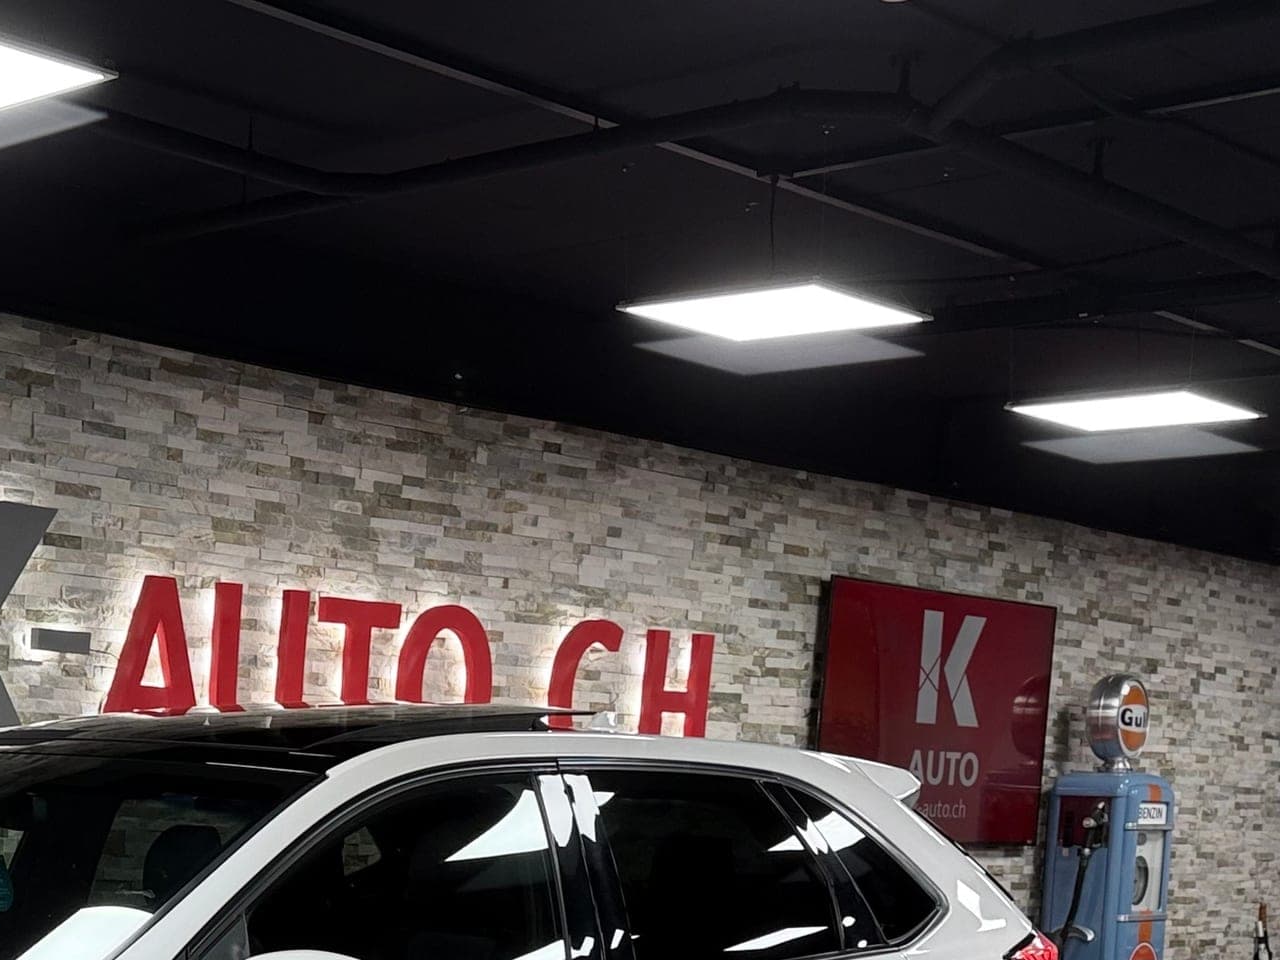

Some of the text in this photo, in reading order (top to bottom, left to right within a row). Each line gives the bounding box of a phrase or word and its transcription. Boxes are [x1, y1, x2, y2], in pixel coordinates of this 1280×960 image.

[916, 609, 987, 728] K
[1121, 708, 1148, 729] Gul
[909, 749, 980, 788] AUTO
[916, 799, 967, 818] -auto.ch
[1138, 807, 1163, 820] BENZIN
